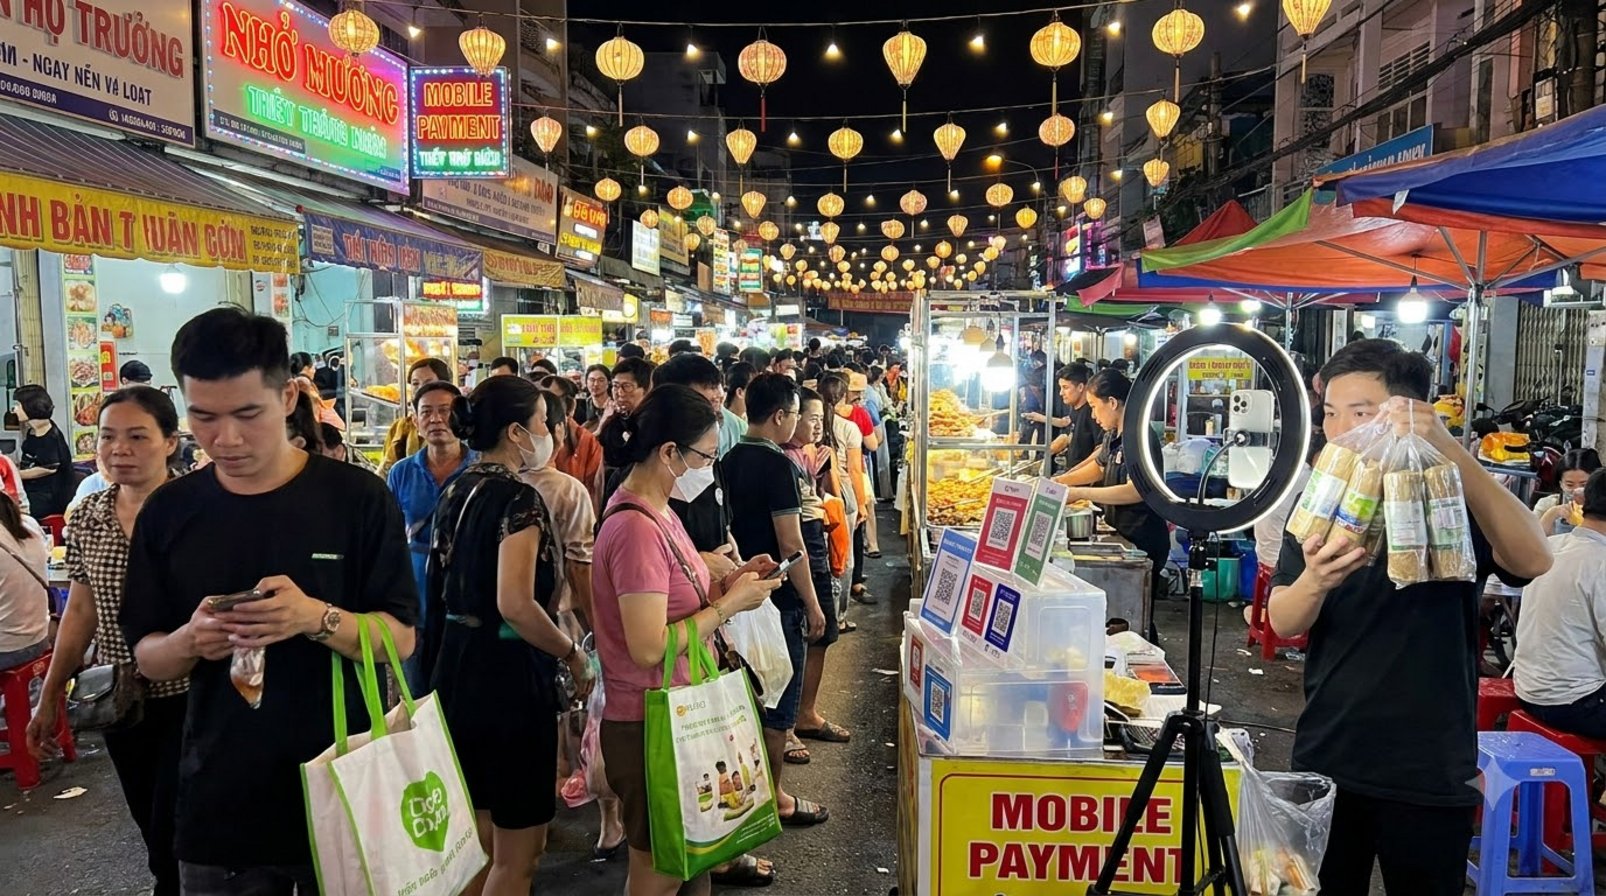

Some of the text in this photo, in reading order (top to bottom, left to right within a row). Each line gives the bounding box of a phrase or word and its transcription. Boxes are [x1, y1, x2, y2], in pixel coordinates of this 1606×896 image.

[75, 1, 184, 78] TRƯỞNG
[33, 53, 70, 81] NGAY
[424, 82, 493, 107] MOBILE
[416, 114, 501, 140] PAYMENT
[991, 793, 1172, 834] MOBILE
